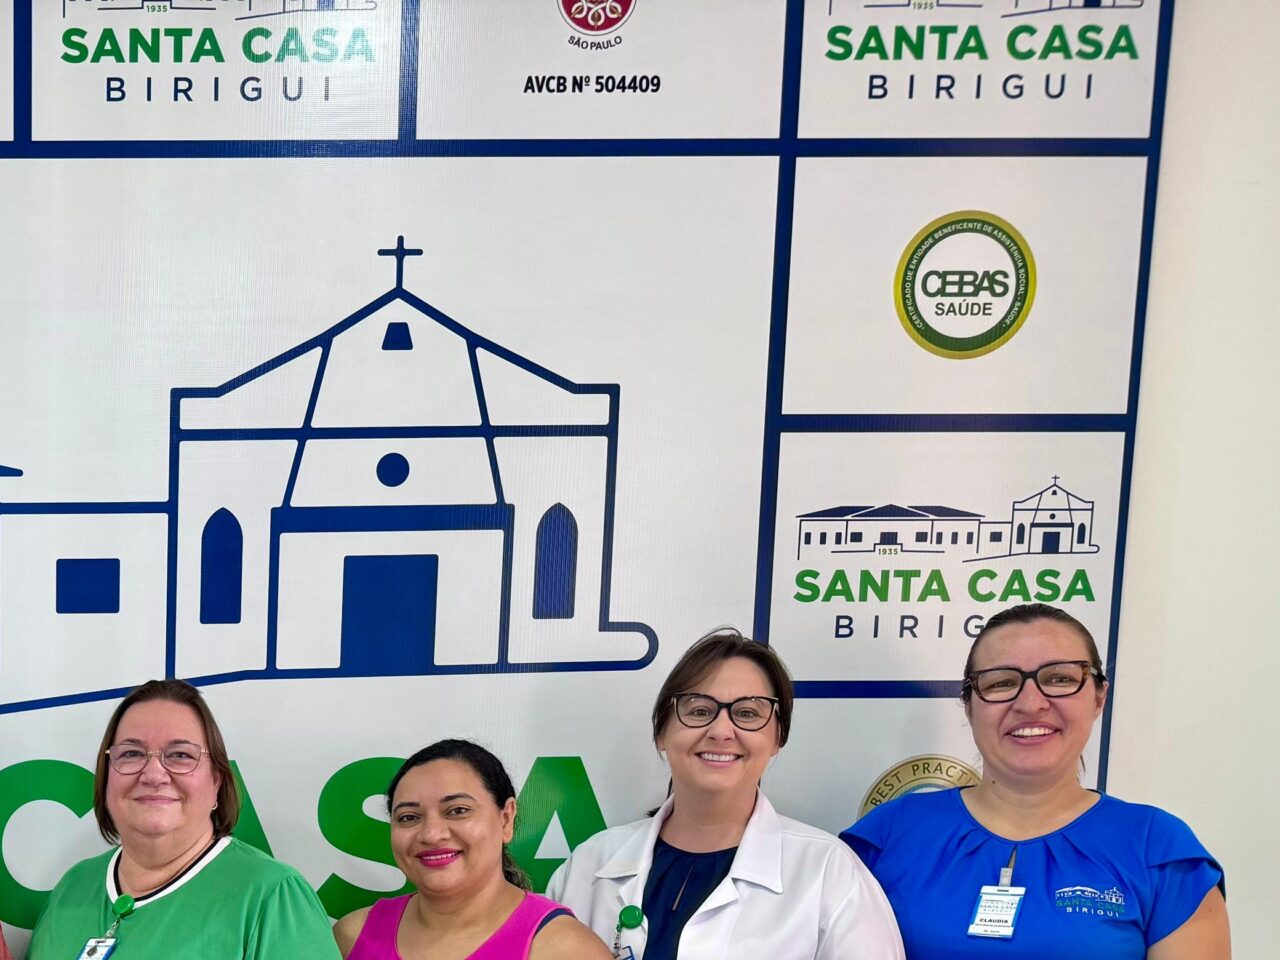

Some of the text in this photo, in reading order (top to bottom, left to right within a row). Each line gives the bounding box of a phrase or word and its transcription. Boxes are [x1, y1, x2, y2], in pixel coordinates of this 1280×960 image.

[61, 27, 376, 63] SANTA CASA
[568, 35, 622, 50] SÃO PAULO
[824, 25, 1139, 61] SANTA CASA
[106, 76, 330, 102] BIRIGUI
[524, 75, 567, 93] AVCB
[594, 75, 661, 93] 504409
[868, 73, 1093, 100] BIRIGUI
[921, 270, 1010, 298] CEBAS
[934, 299, 993, 316] SAÚDE
[793, 568, 1096, 603] SANTA CASA
[835, 615, 986, 639] BIRIG
[870, 771, 902, 806] BEST
[1066, 906, 1119, 918] BIRIGUI
